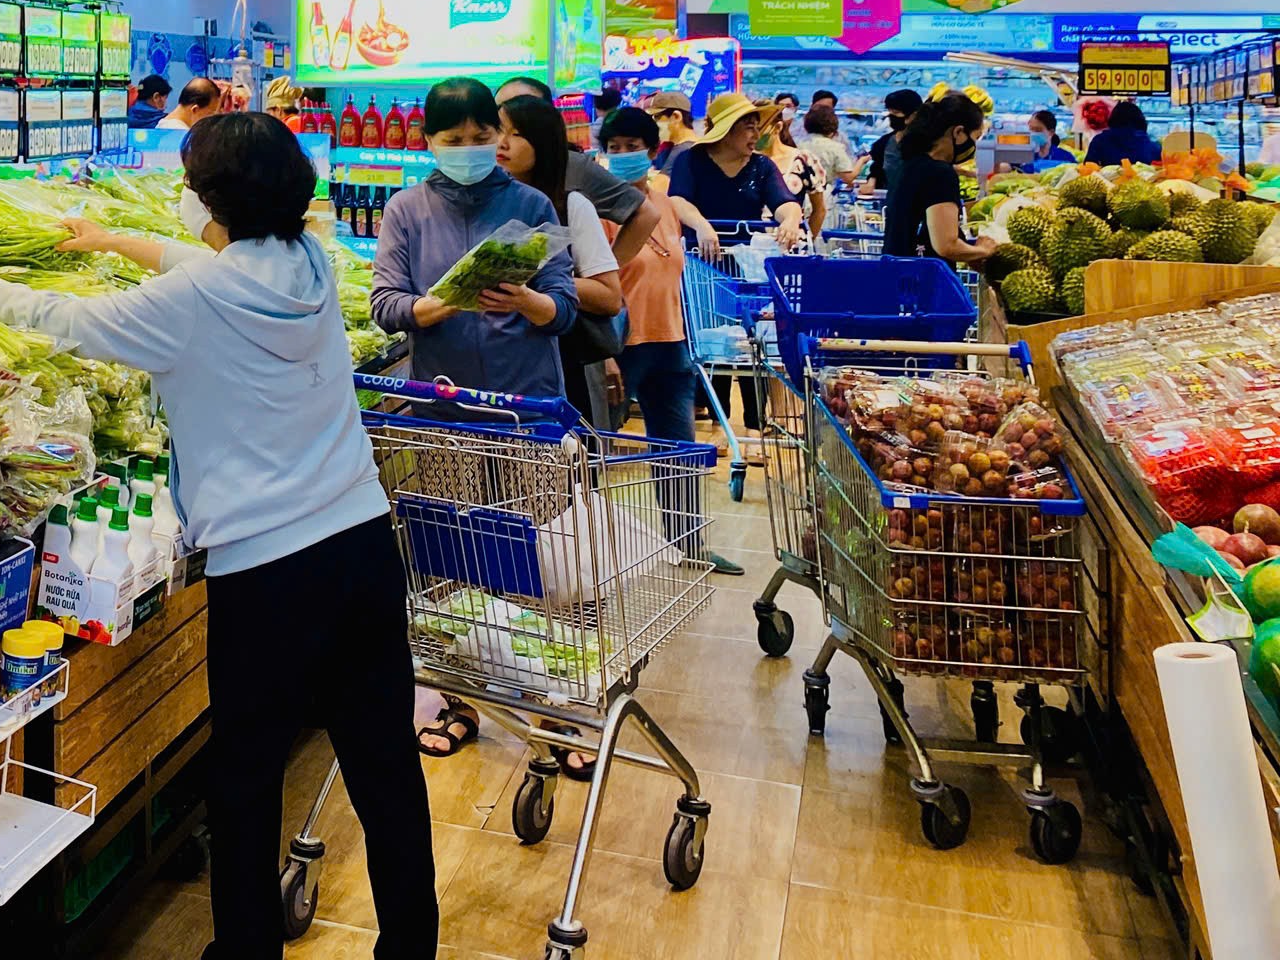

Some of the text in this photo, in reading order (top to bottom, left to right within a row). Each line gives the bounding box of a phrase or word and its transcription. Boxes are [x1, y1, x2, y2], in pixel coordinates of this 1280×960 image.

[1088, 72, 1150, 86] 59.900
[45, 570, 83, 586] Botanika
[46, 584, 80, 601] NƯỚC RỬA
[46, 596, 76, 610] RAU QUẢ
